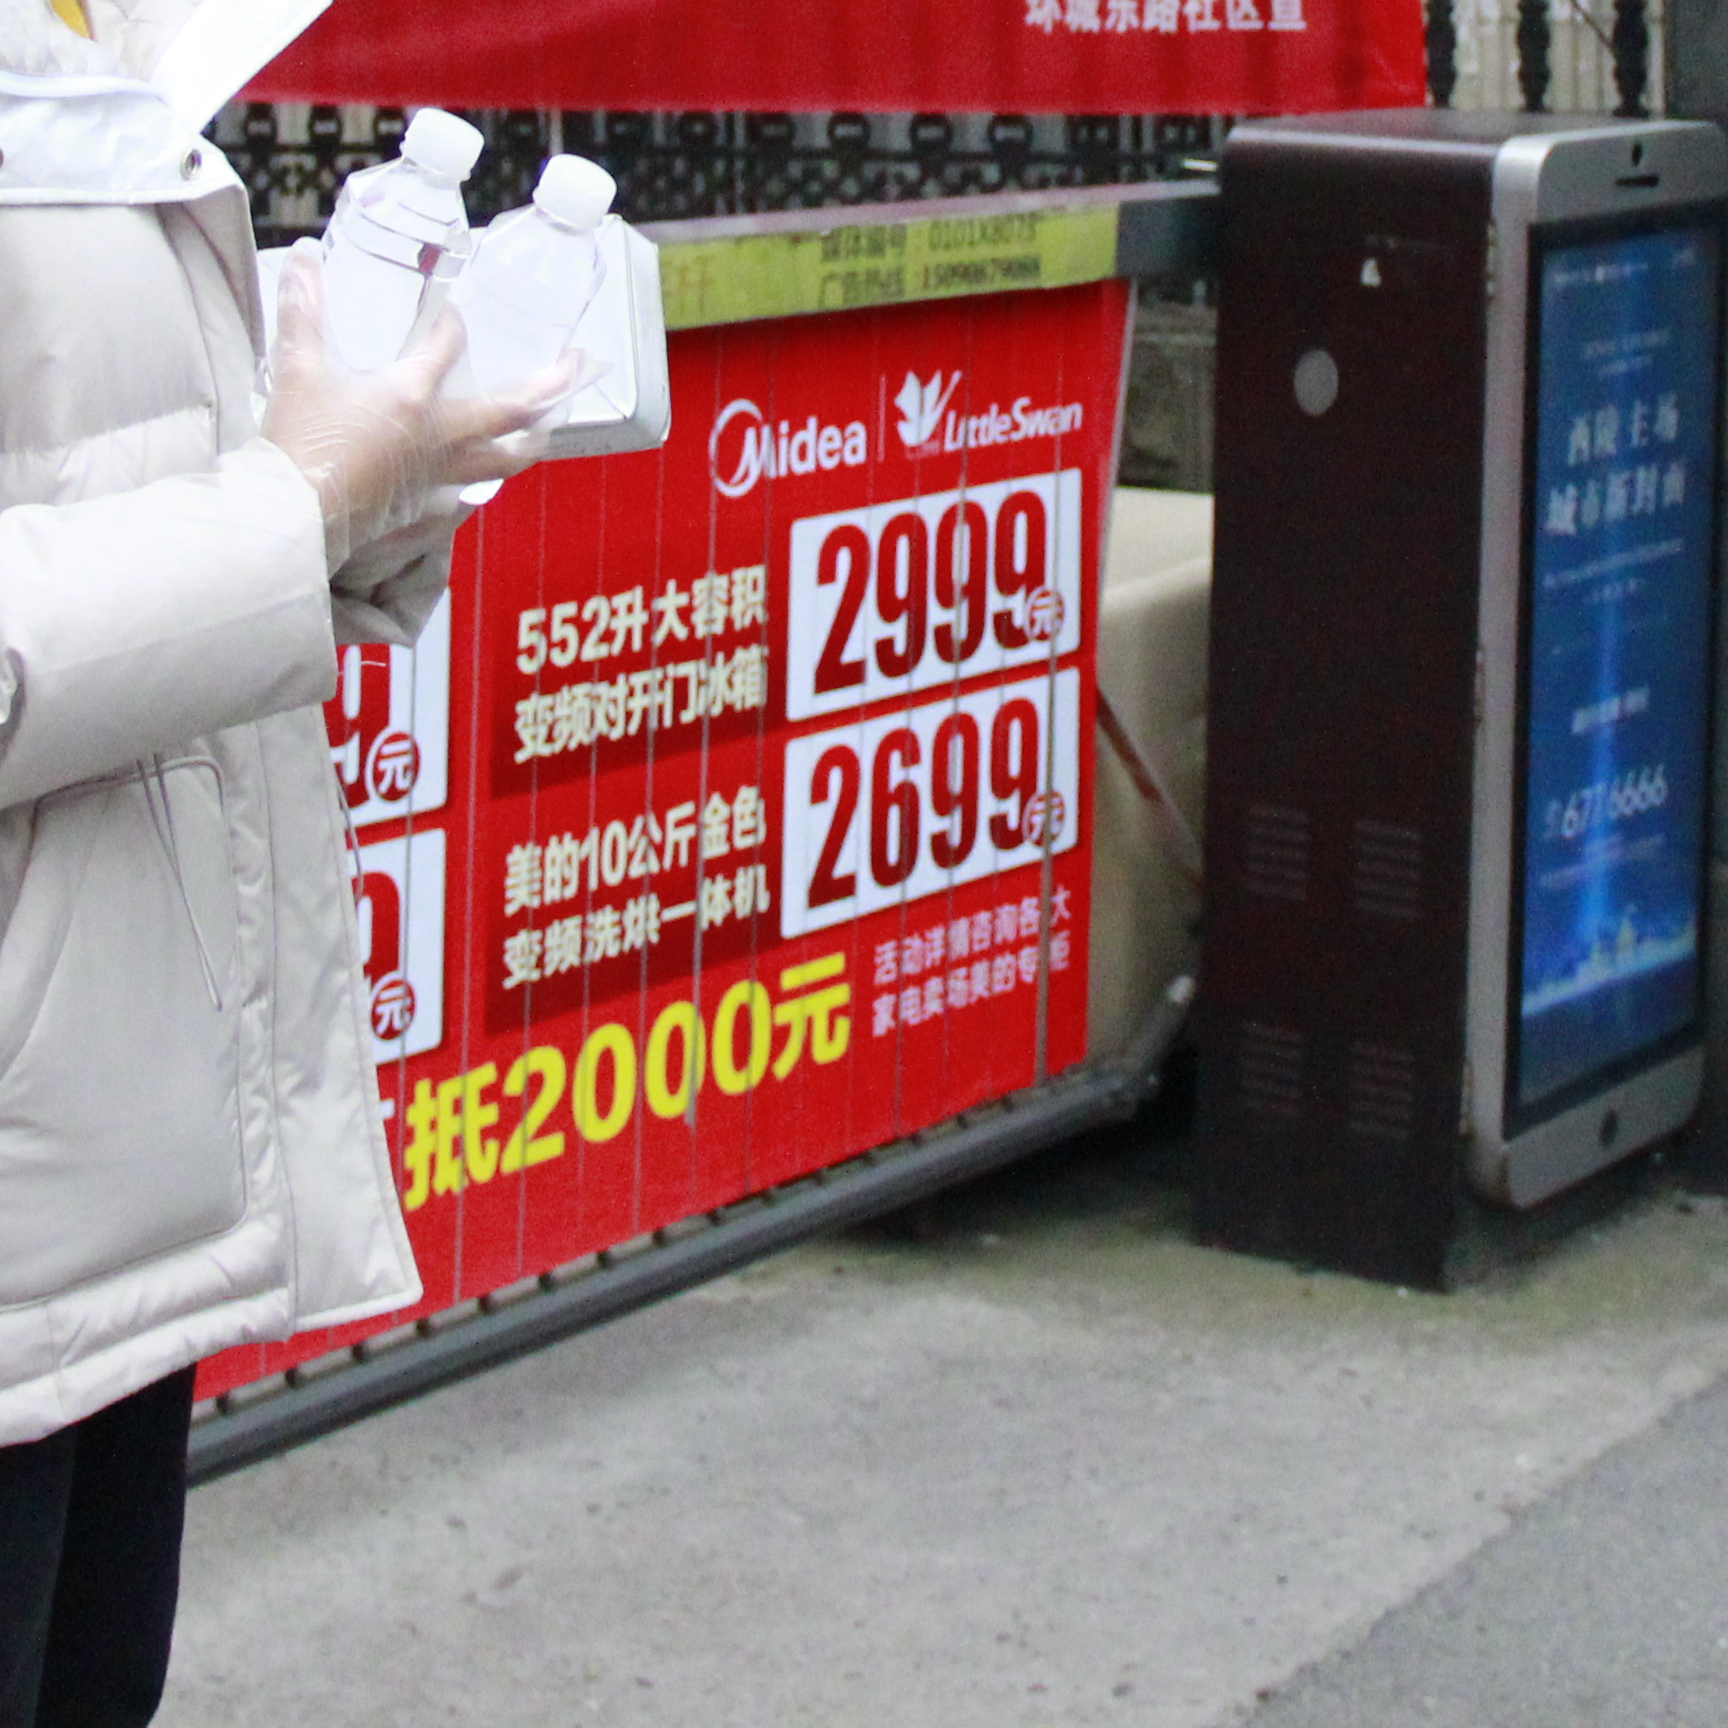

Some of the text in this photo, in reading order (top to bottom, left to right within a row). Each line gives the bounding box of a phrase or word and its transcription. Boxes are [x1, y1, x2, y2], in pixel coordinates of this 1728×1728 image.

[709, 398, 868, 498] Midea
[516, 564, 768, 675] 552升大容积
[513, 643, 769, 766] 变频对开门冰箱
[504, 785, 768, 917] 美的10公斤金色
[501, 863, 771, 990] 变频洗烘一体机
[404, 952, 852, 1213] 抵2000元
